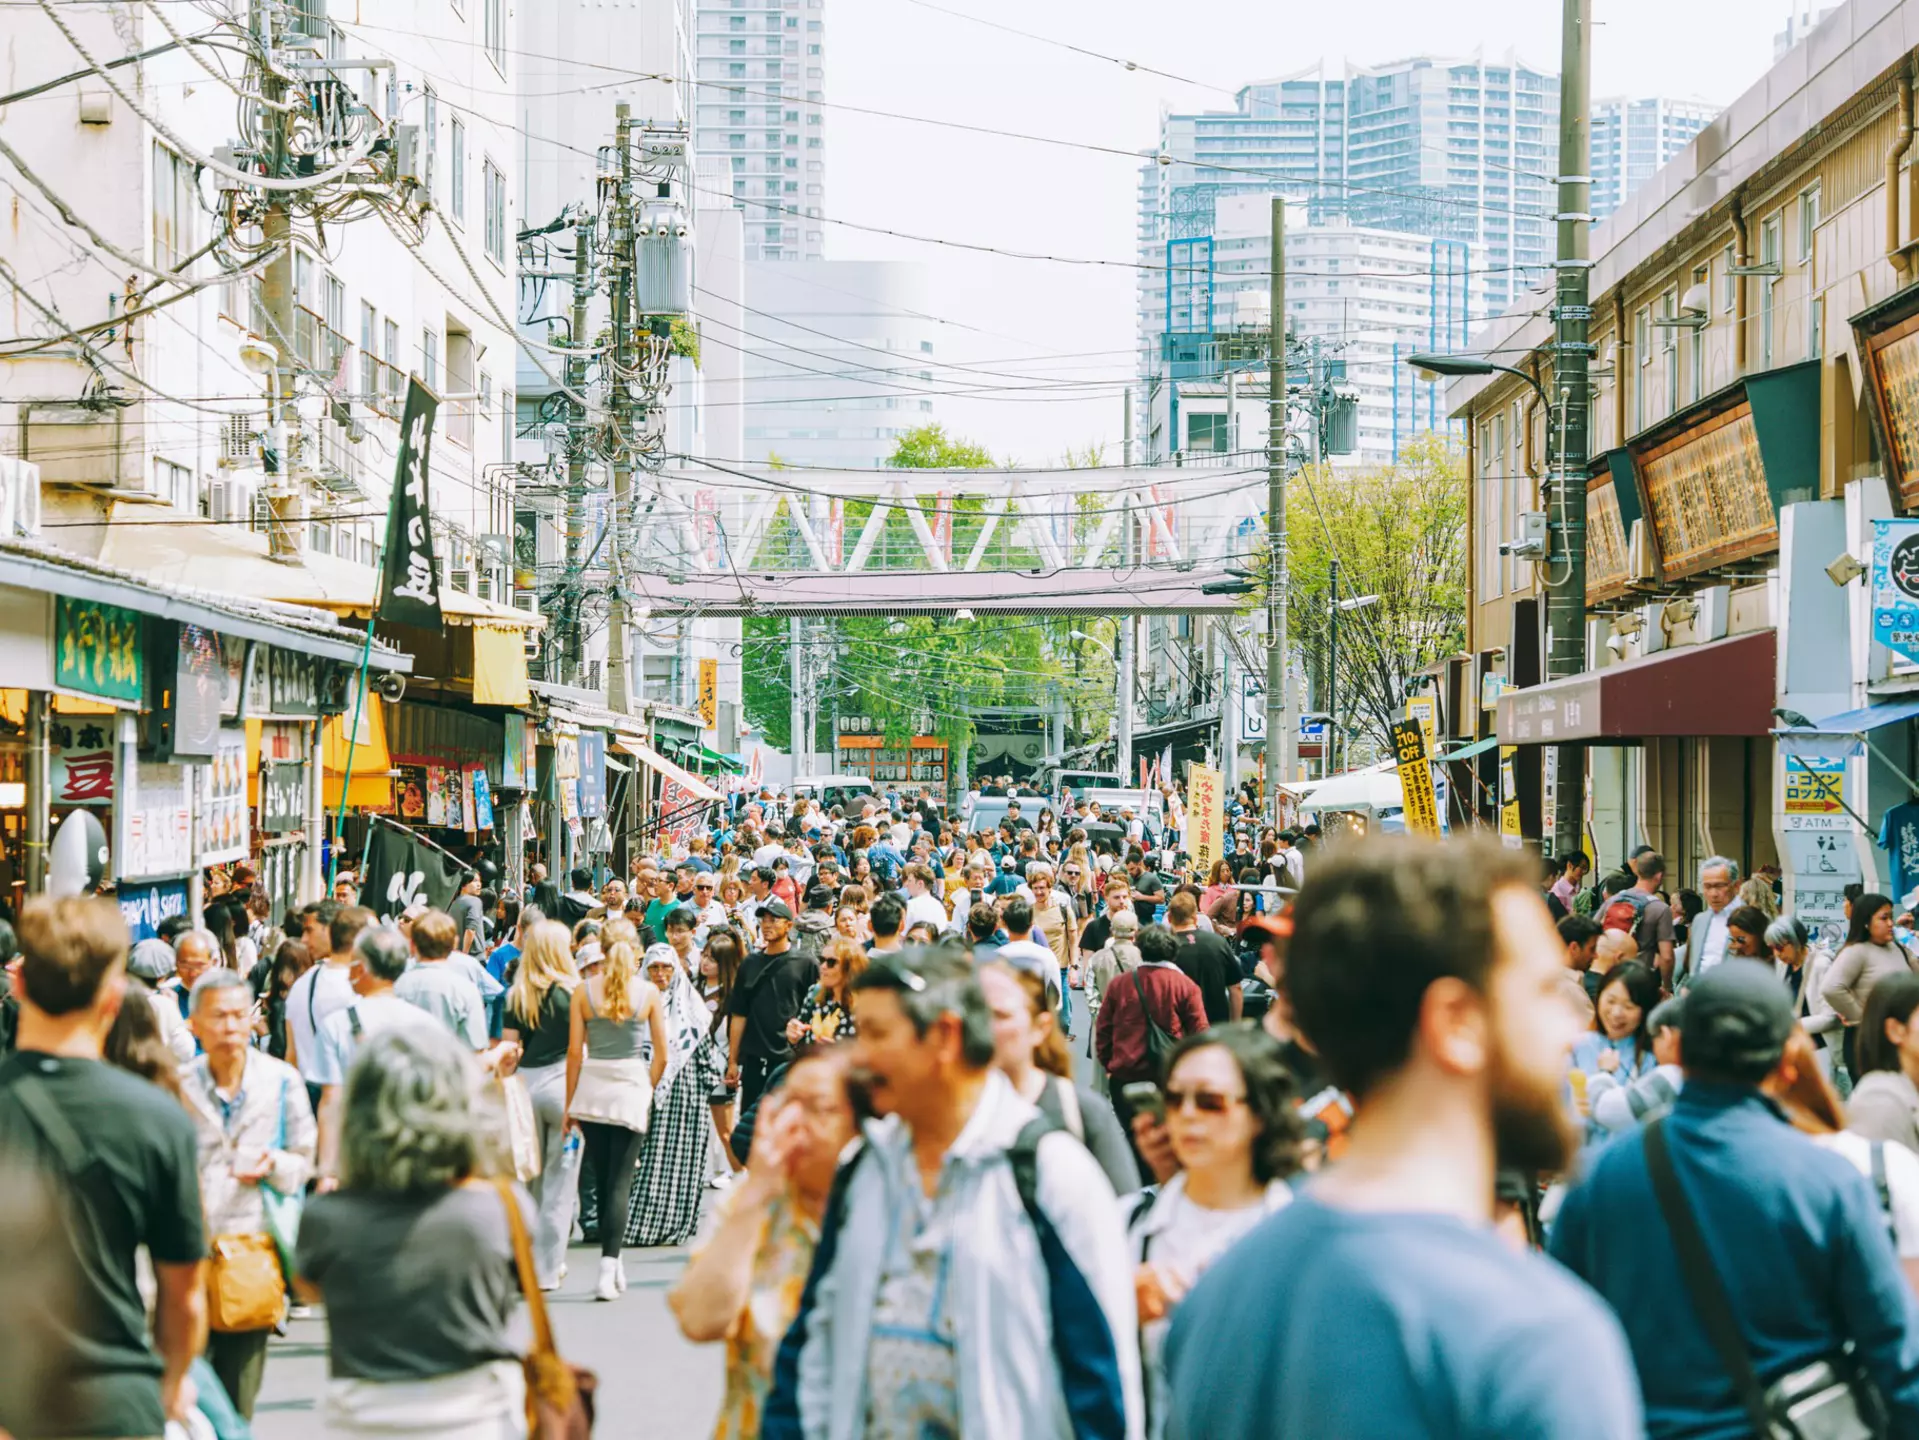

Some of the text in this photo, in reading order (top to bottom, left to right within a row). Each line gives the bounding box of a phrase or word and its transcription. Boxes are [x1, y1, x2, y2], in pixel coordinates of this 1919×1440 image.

[1400, 745, 1420, 761] OFF
[60, 750, 115, 801] 豆
[1800, 774, 1840, 786] コイン
[1787, 787, 1841, 800] ロッカー
[1804, 818, 1833, 828] ATM
